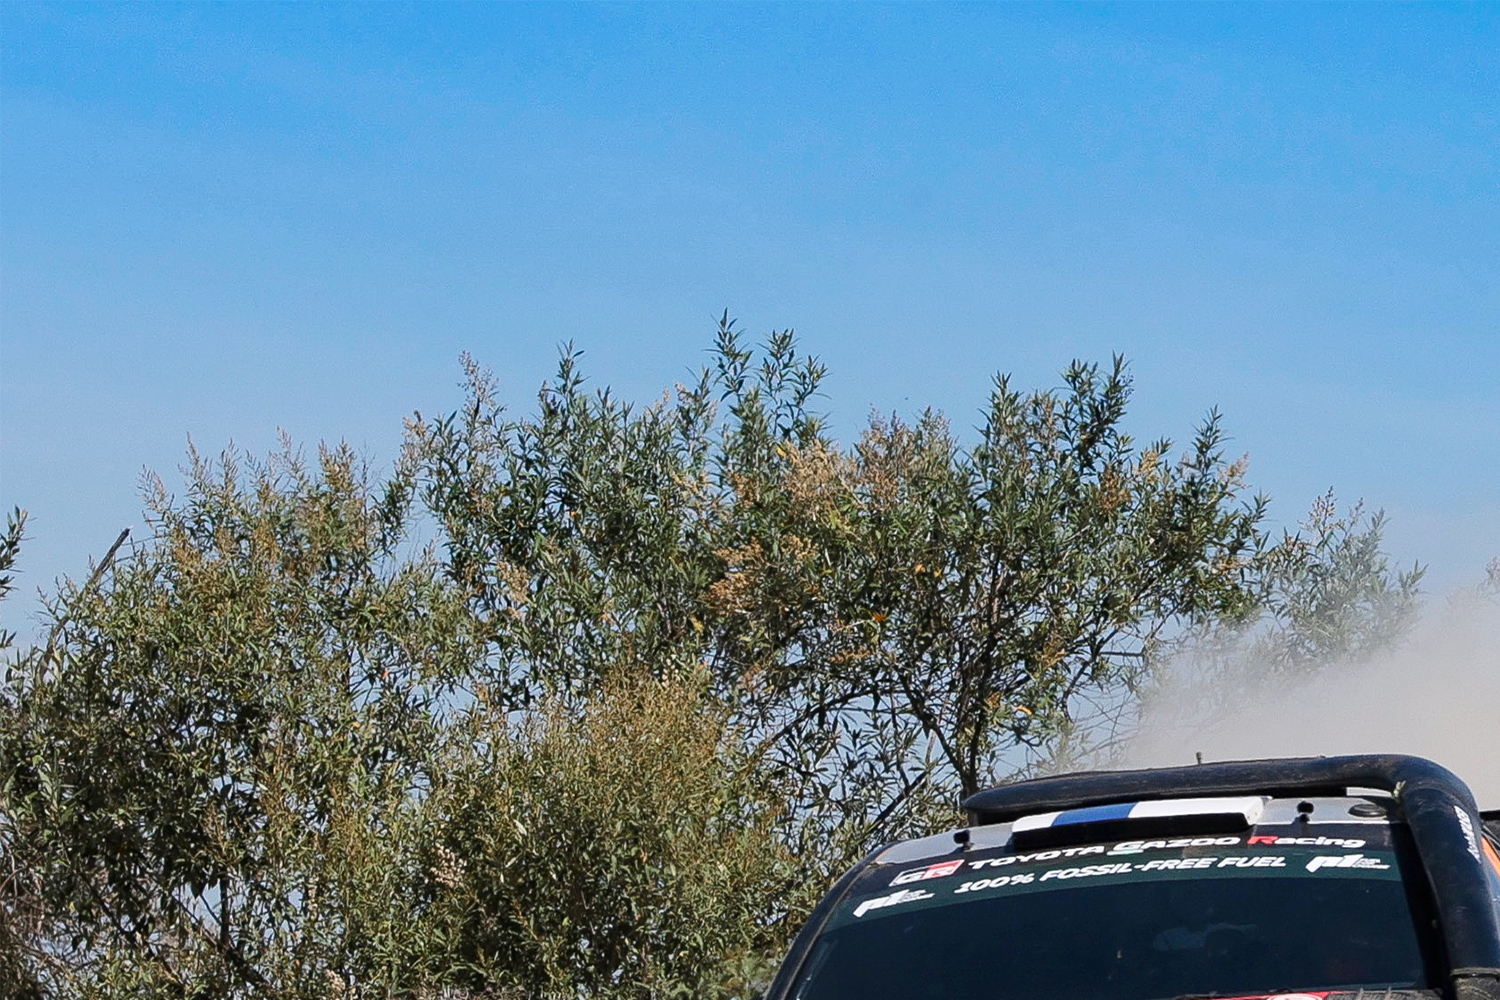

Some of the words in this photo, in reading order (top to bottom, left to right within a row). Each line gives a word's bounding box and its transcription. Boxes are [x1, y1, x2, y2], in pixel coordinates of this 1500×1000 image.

[889, 860, 965, 887] GR
[969, 846, 1106, 870] TOYOTA
[1106, 837, 1241, 855] GAZOO
[1247, 836, 1367, 849] Racing
[954, 877, 1034, 894] 100%
[1040, 857, 1218, 882] FOSSIL-FREE
[1217, 857, 1287, 868] FUEL
